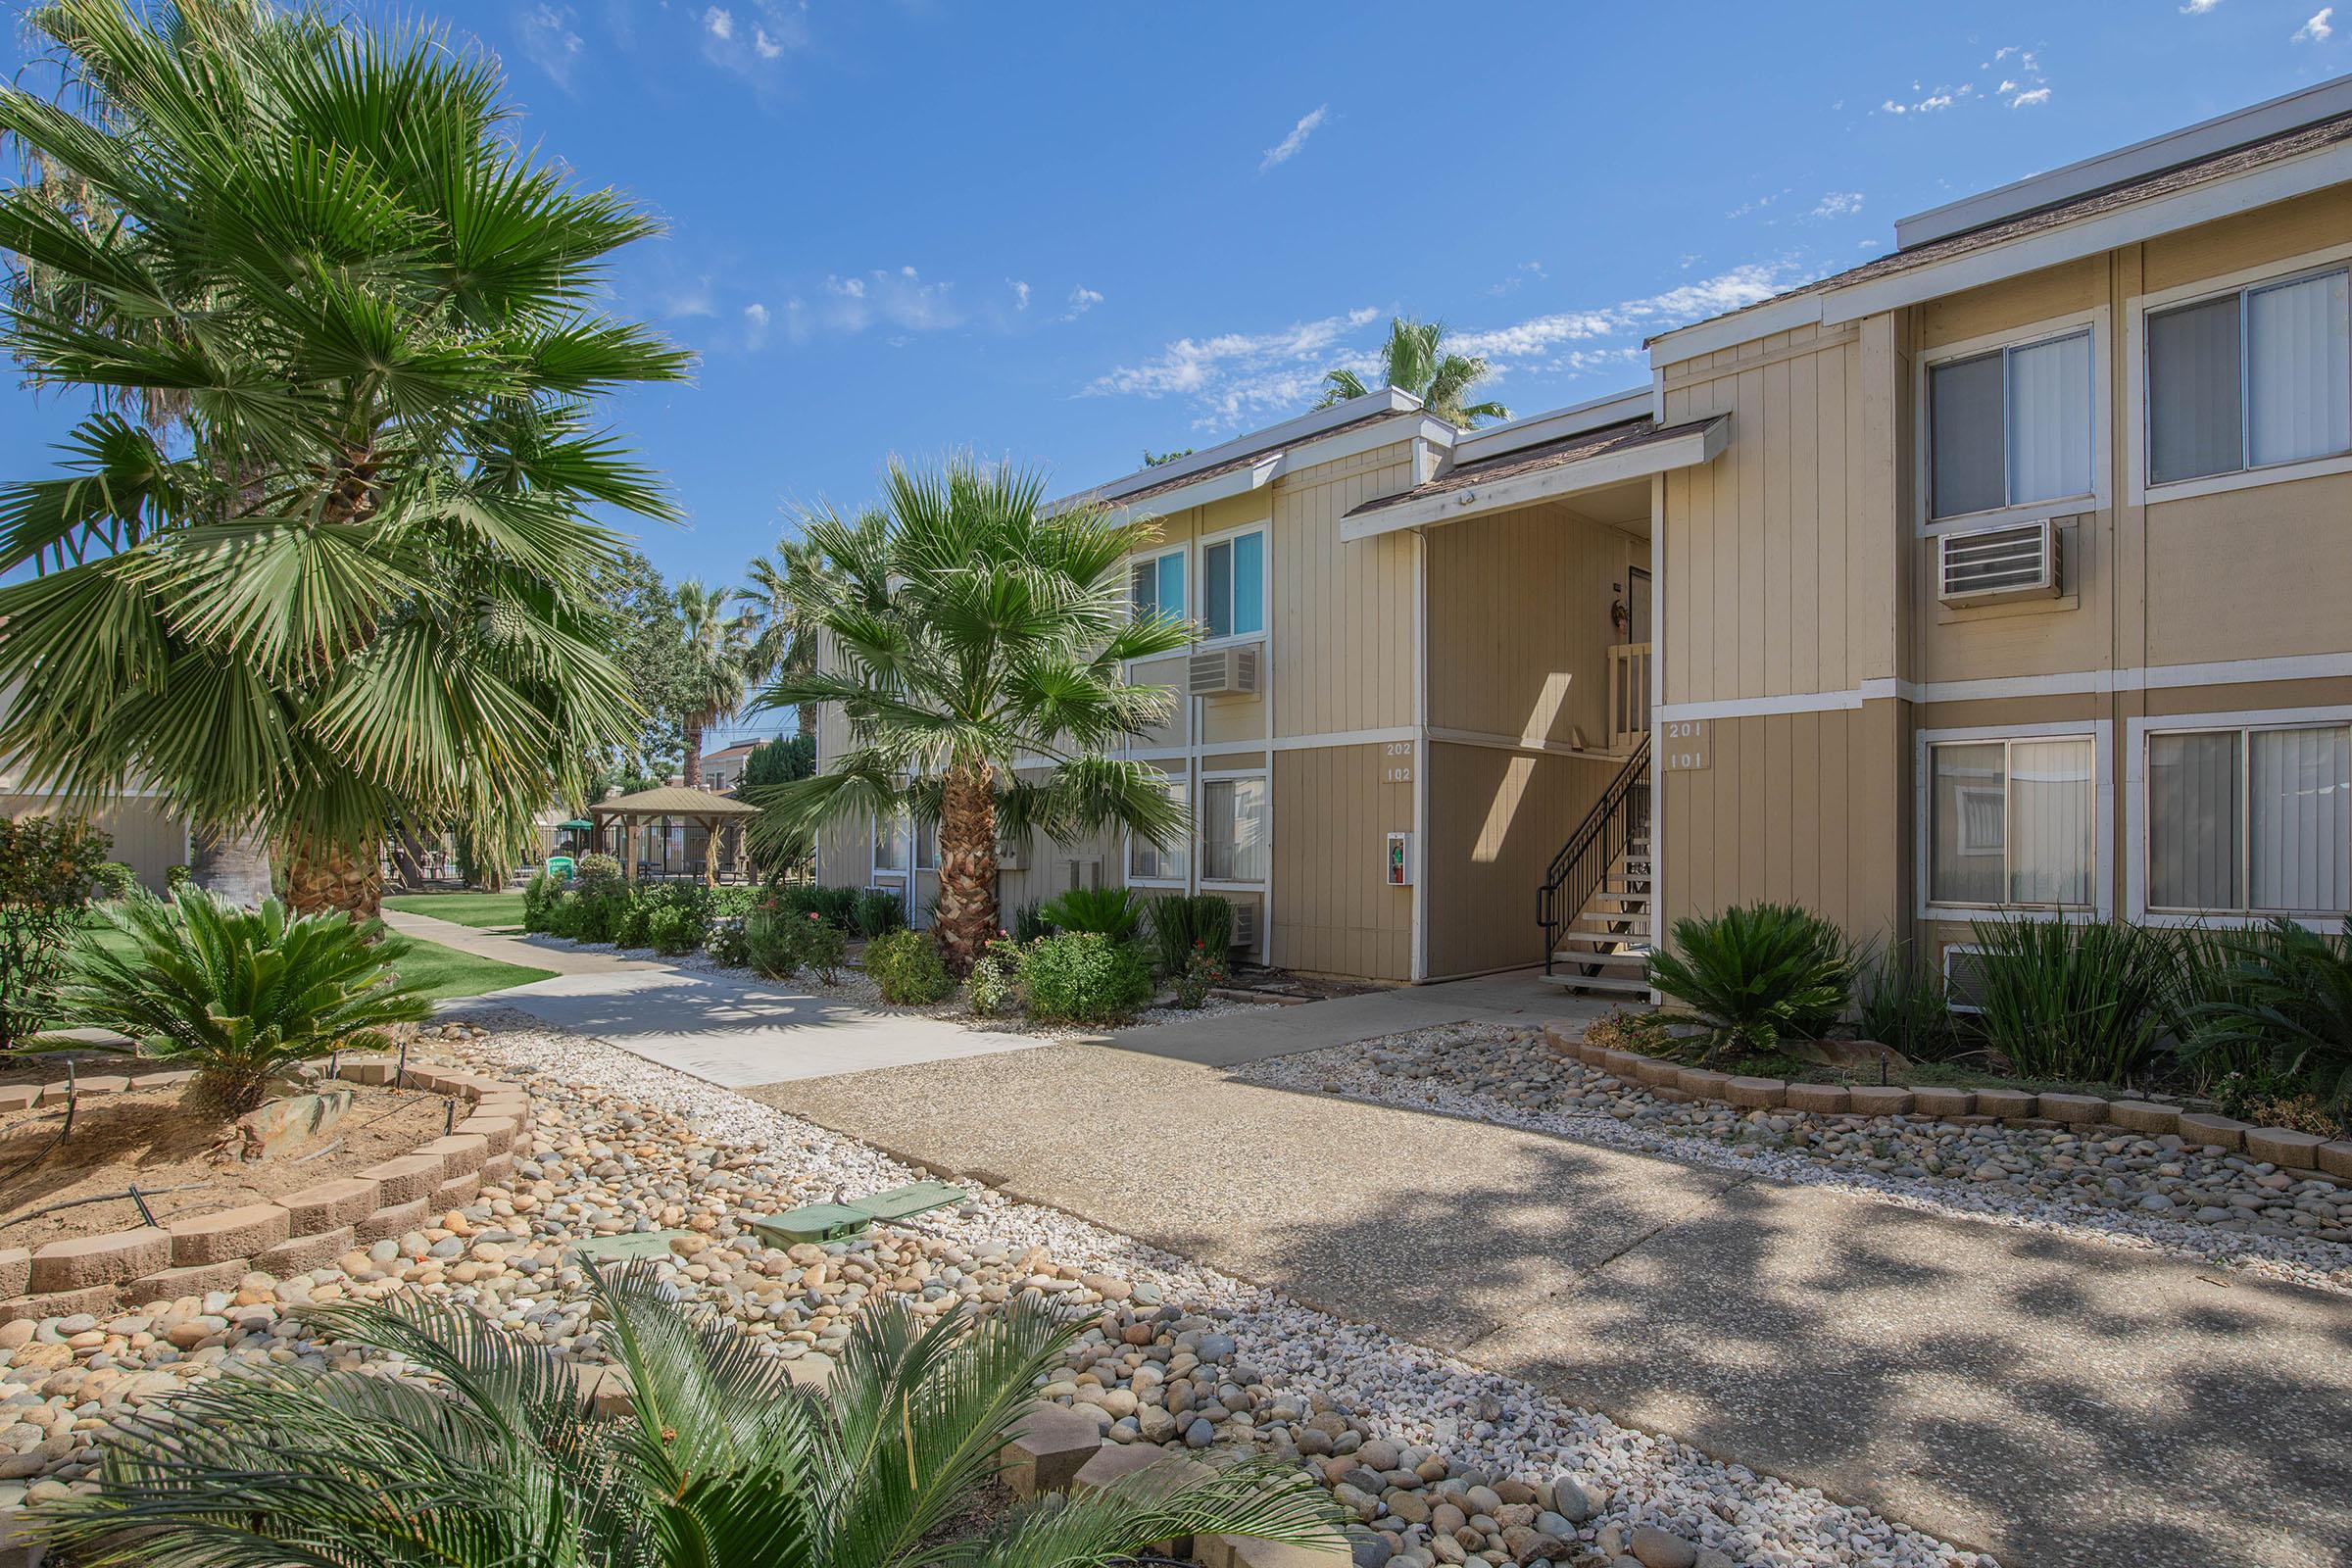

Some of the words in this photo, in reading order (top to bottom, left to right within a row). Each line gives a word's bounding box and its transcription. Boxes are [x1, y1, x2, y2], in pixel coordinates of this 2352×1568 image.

[1670, 722, 1699, 738] 201
[1387, 743, 1411, 756] 202
[1672, 753, 1700, 768] 101
[1389, 768, 1410, 782] 102
